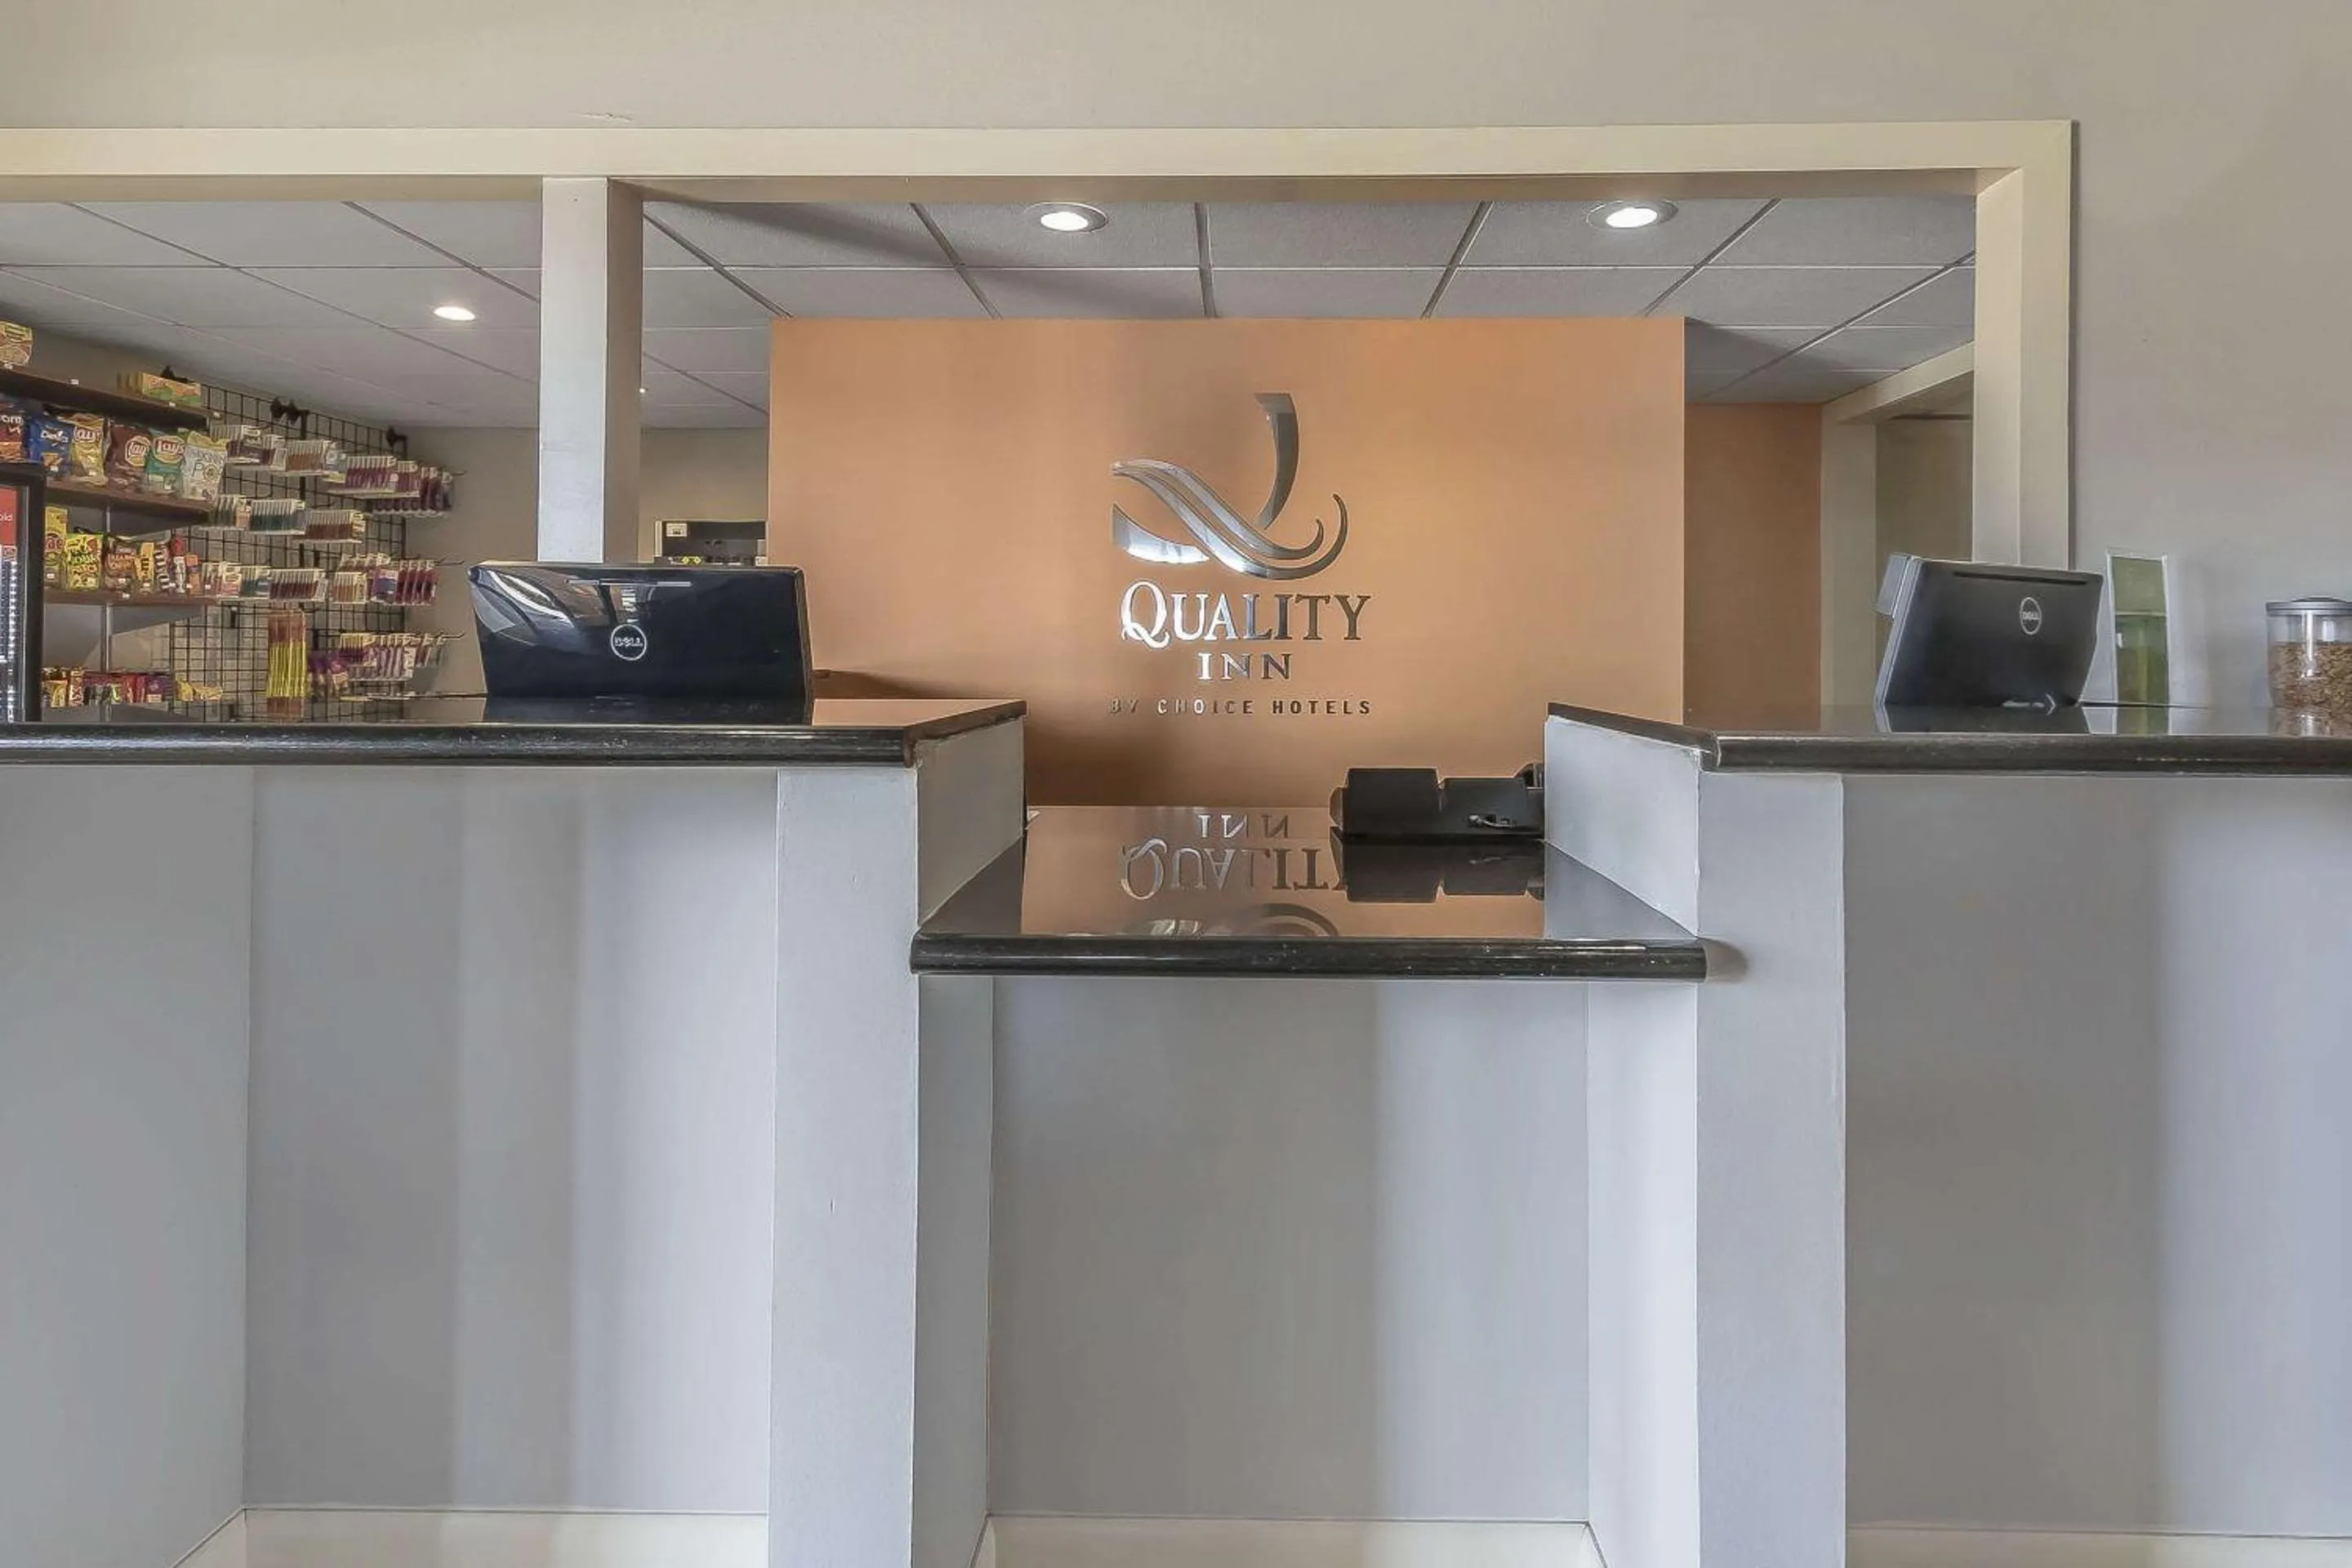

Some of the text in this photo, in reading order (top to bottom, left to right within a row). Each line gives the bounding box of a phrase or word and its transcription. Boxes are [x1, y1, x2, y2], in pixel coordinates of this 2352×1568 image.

[1120, 580, 1371, 649] QUALITY
[614, 636, 644, 647] DELL
[1196, 653, 1293, 680] INN
[1110, 698, 1370, 715] BY CHOICE HOTELS
